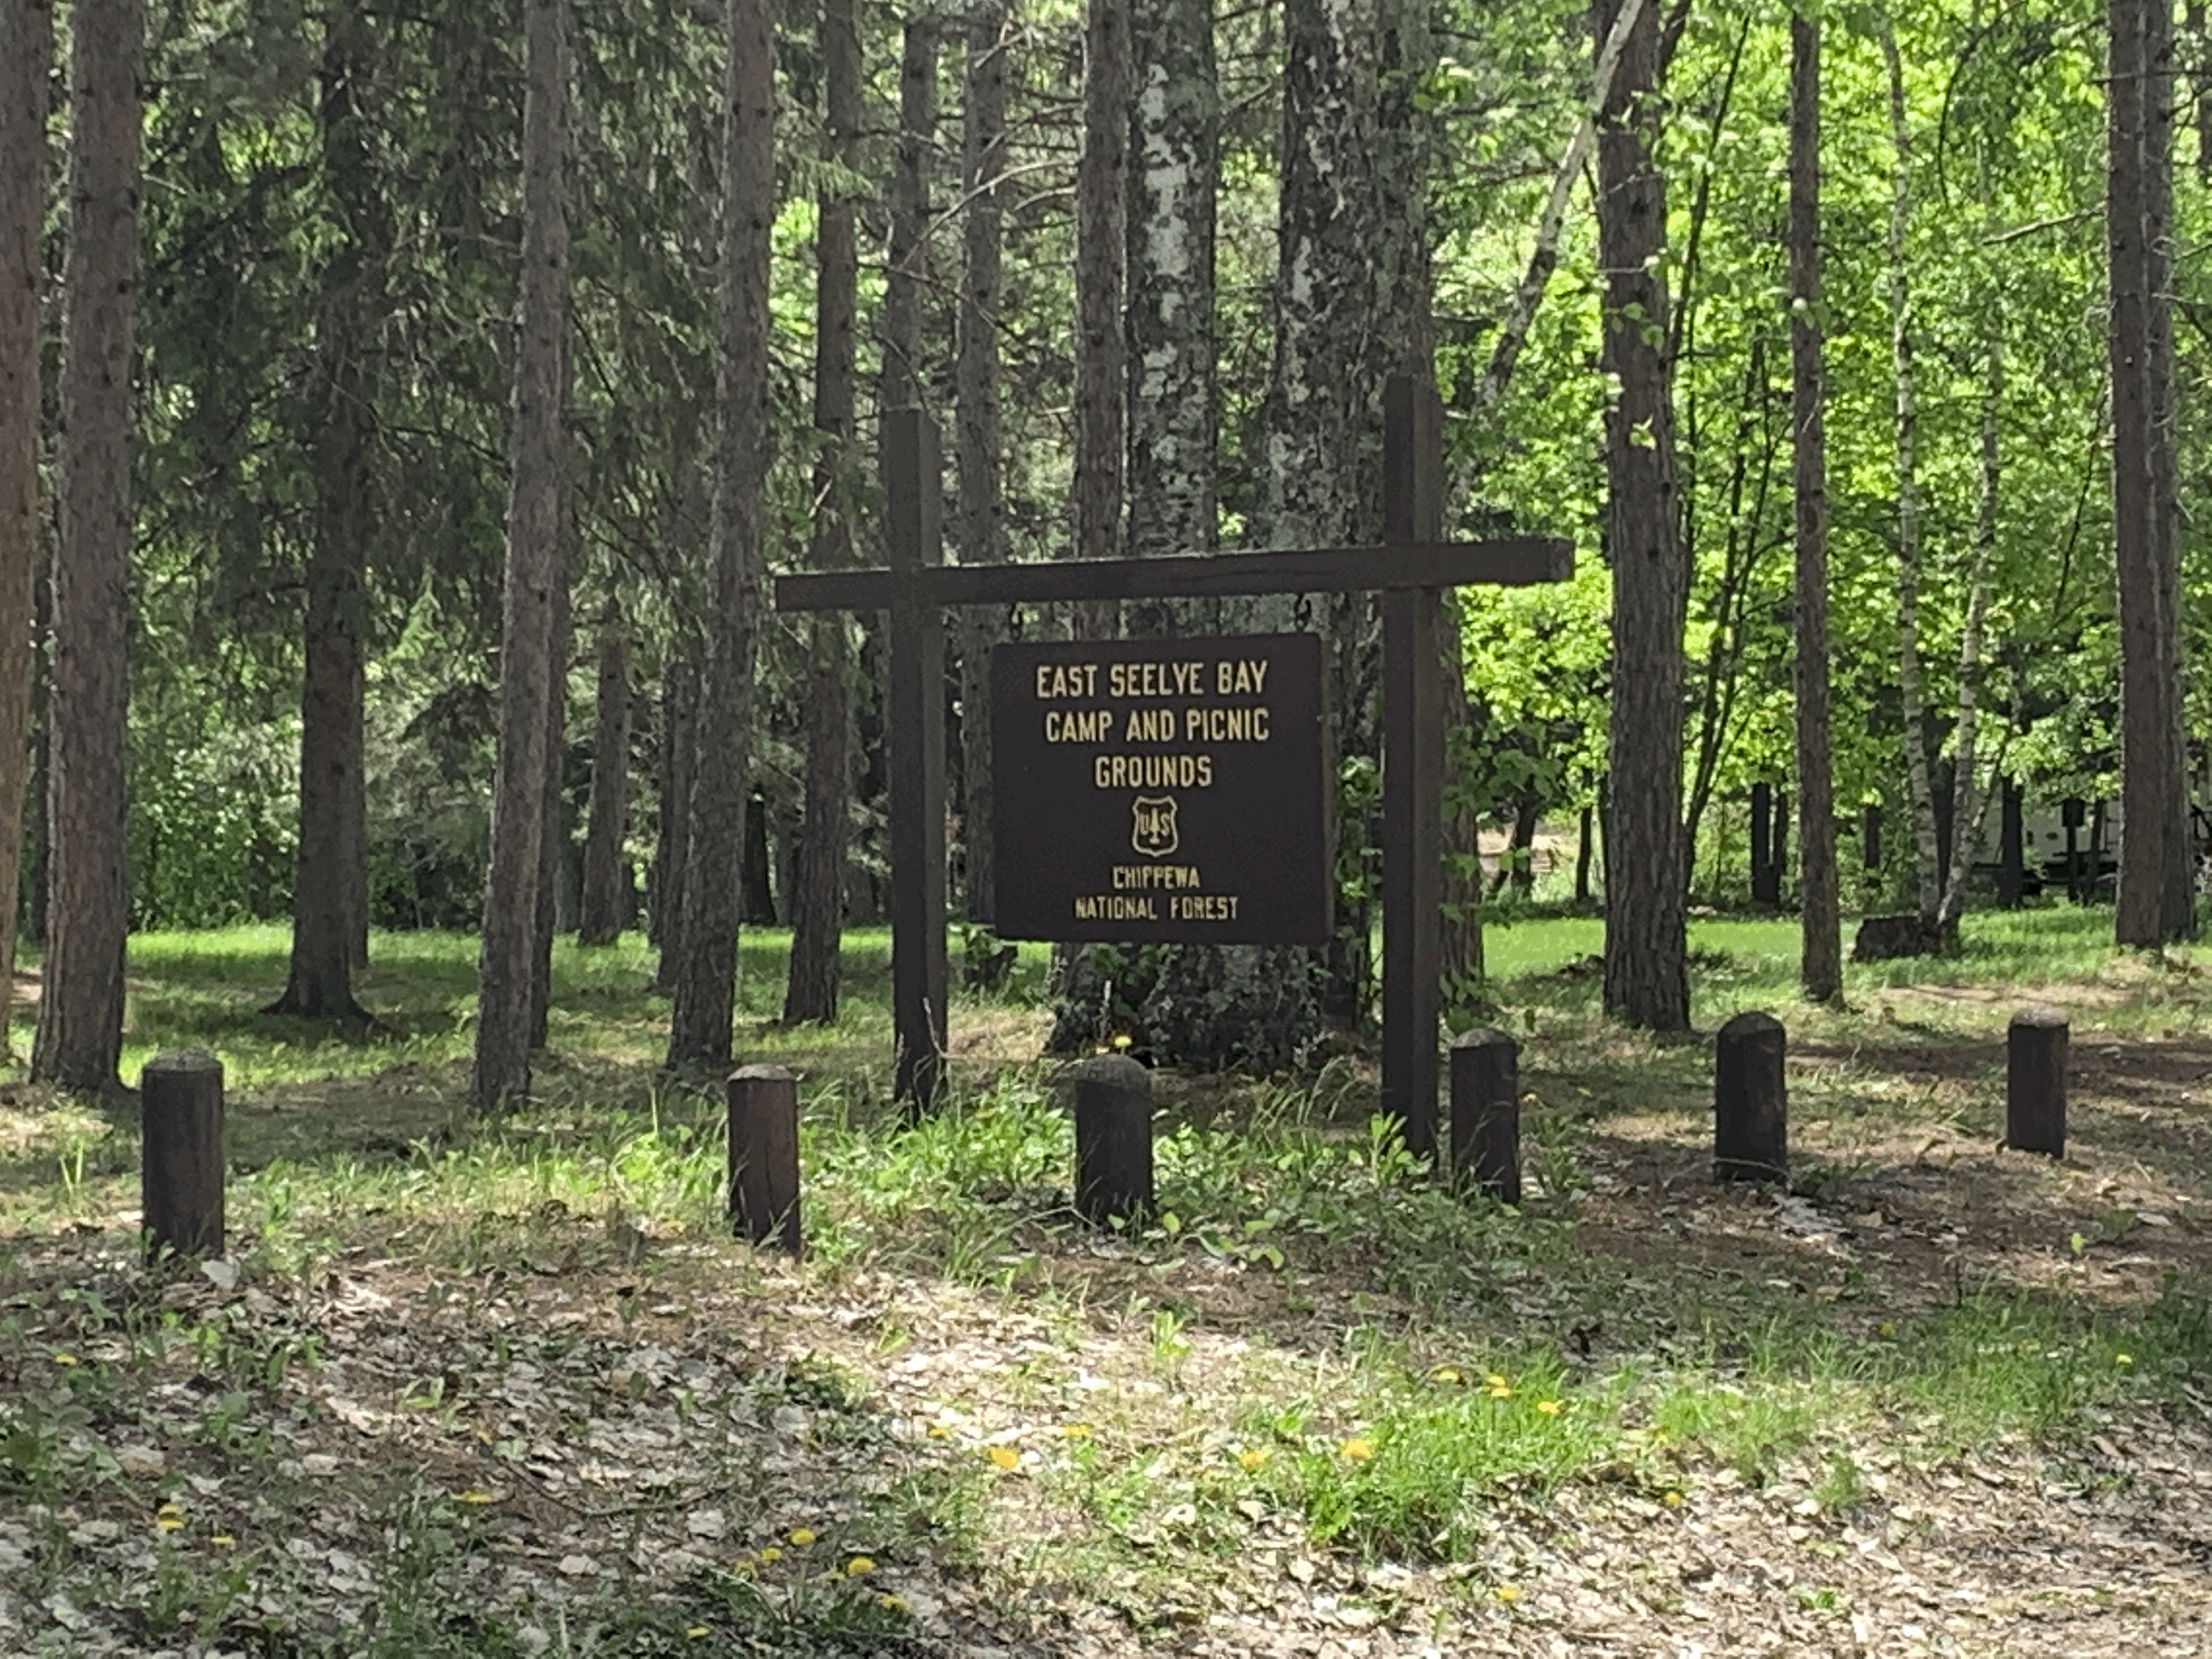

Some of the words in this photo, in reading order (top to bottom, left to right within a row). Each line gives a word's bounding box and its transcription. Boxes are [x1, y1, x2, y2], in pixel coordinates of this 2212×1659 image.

[1037, 664, 1098, 698] EAST
[1110, 662, 1204, 697] SEELYE
[1218, 660, 1267, 694] BAY
[1046, 710, 1113, 742] CAMP
[1126, 709, 1175, 742] AND
[1186, 708, 1269, 741] PICNIC
[1095, 755, 1212, 788] GROUNDS
[1113, 865, 1200, 889] CHIPPEWA
[1075, 896, 1158, 920] NATIONAL
[1170, 896, 1238, 919] FOREST
